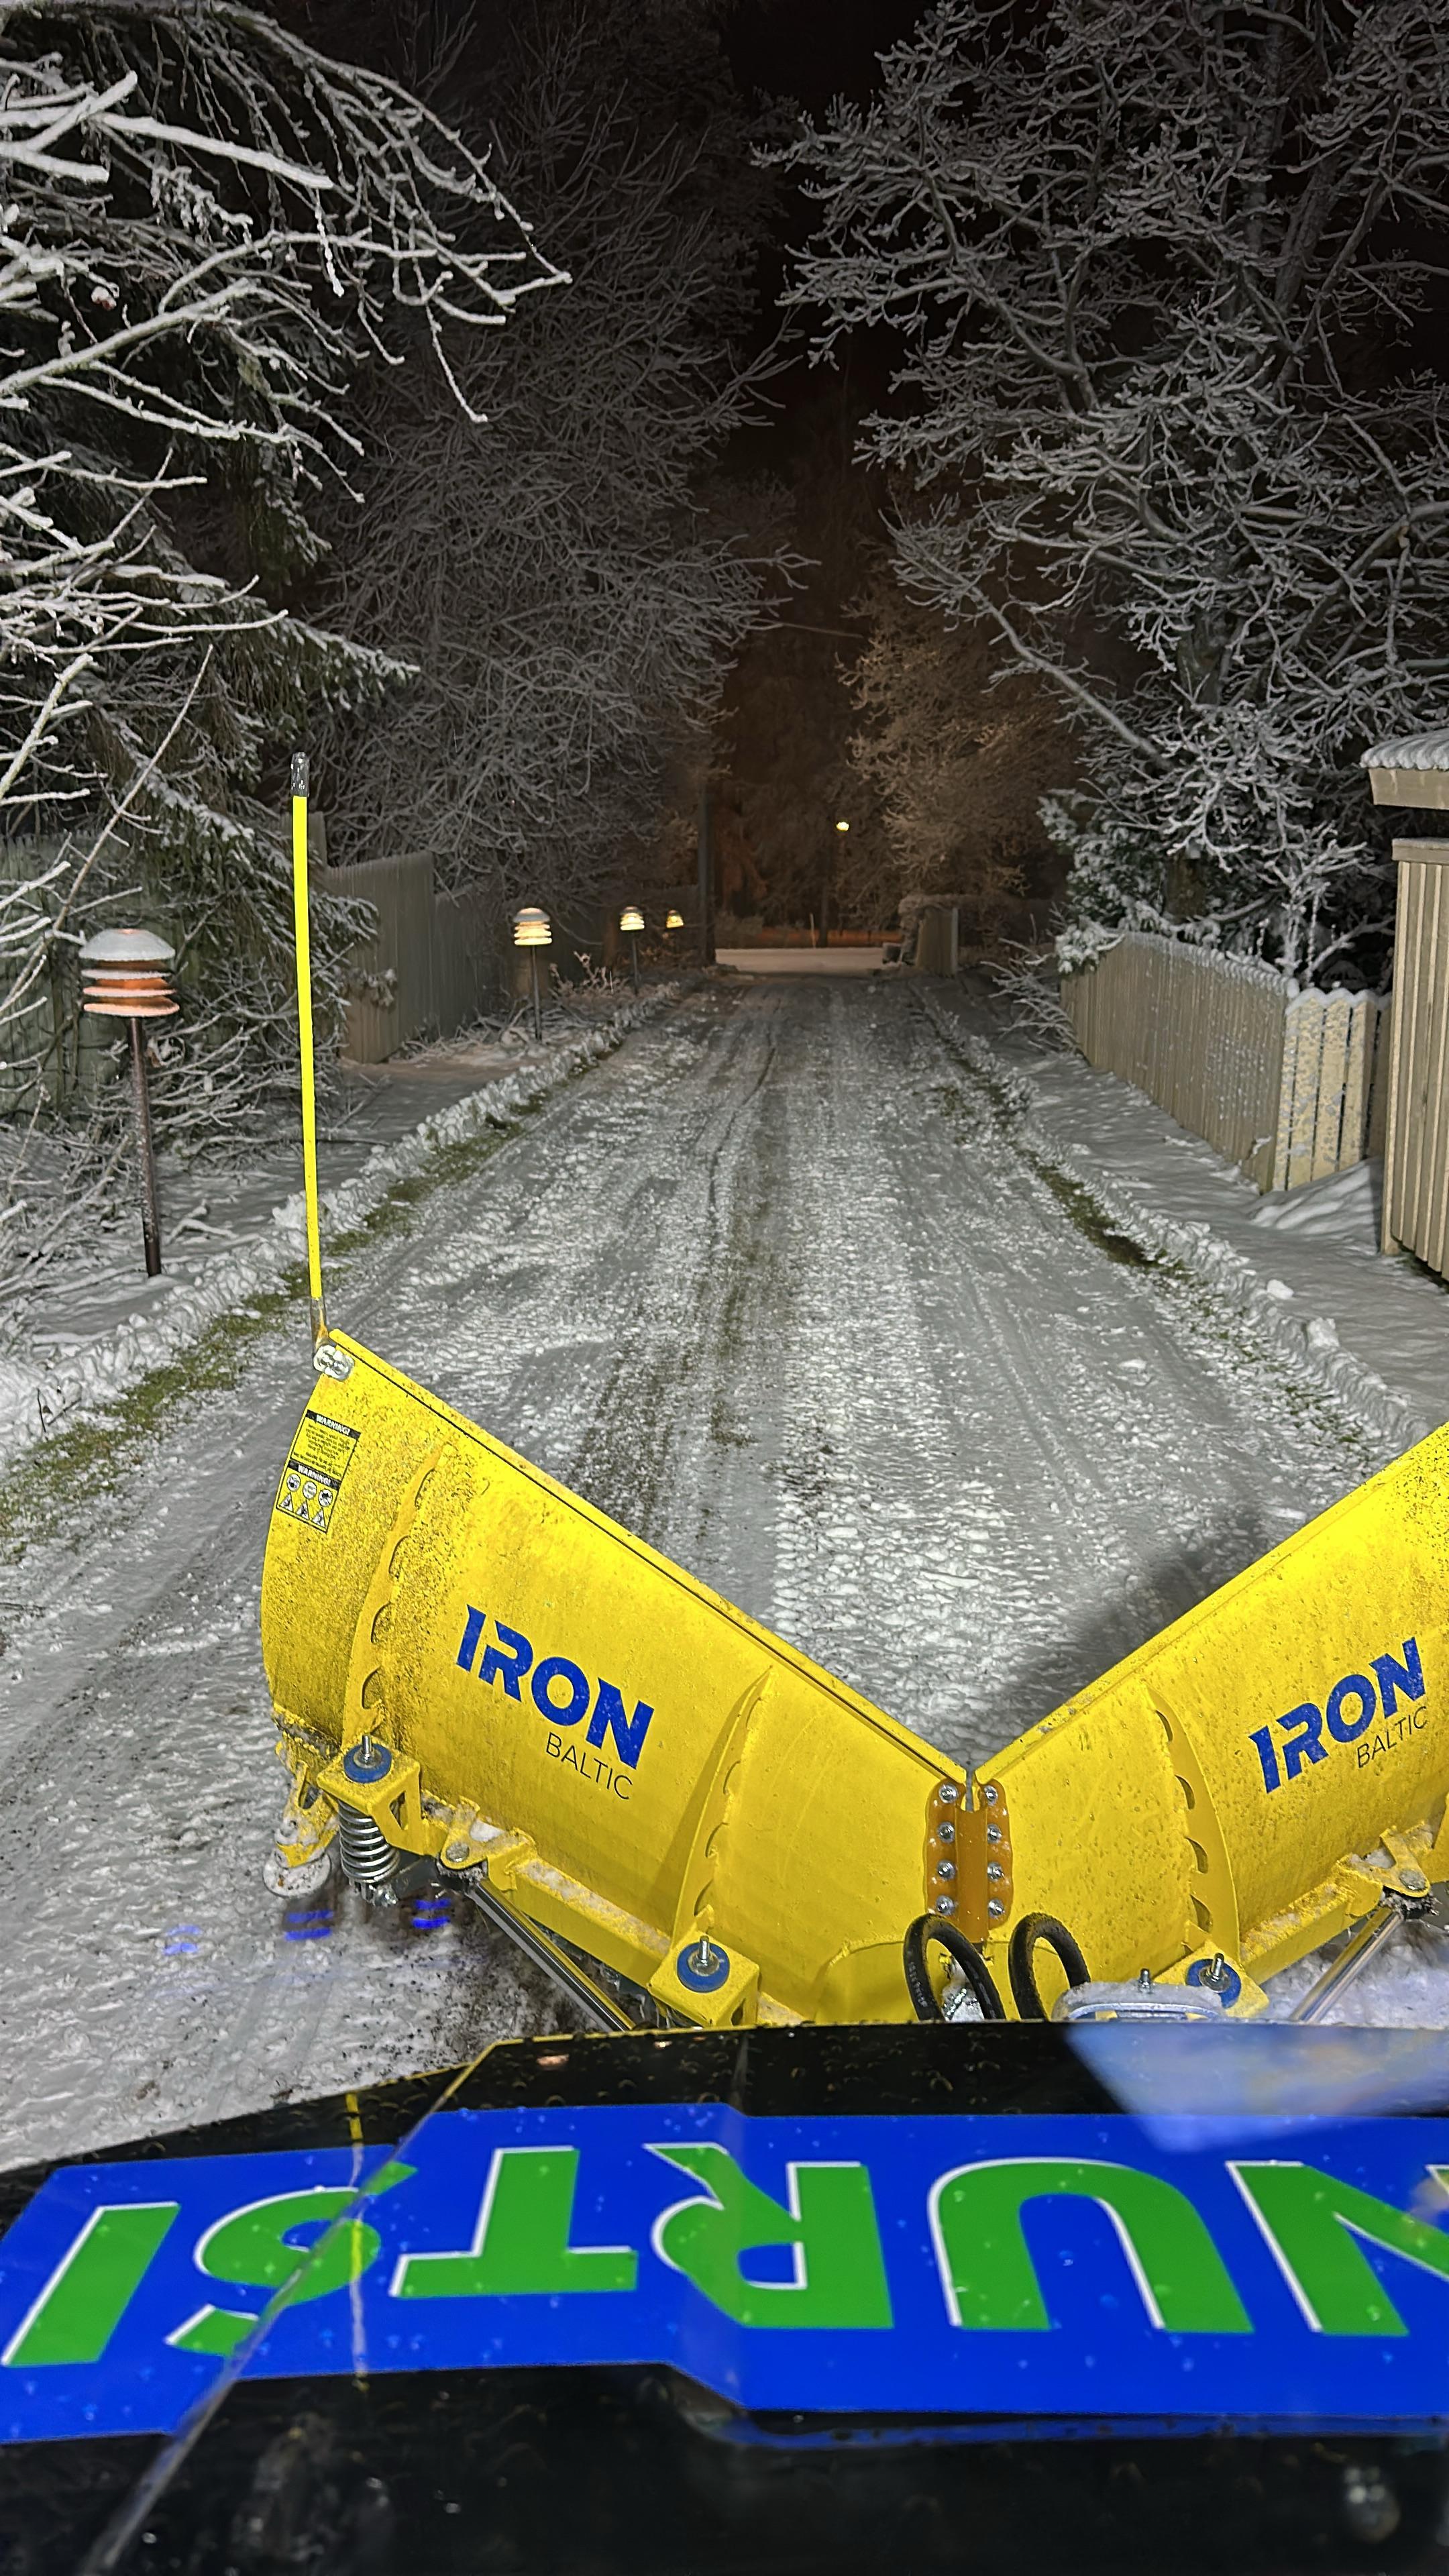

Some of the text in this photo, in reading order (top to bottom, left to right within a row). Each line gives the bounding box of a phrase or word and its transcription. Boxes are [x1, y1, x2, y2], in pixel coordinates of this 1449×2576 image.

[316, 1413, 351, 1436] WARNING!
[297, 1464, 332, 1487] WARNING!
[456, 1604, 655, 1770] IRON
[1248, 1636, 1426, 1794] IRON
[545, 1731, 633, 1801] BALTIC
[1356, 1705, 1428, 1768] BALTIC
